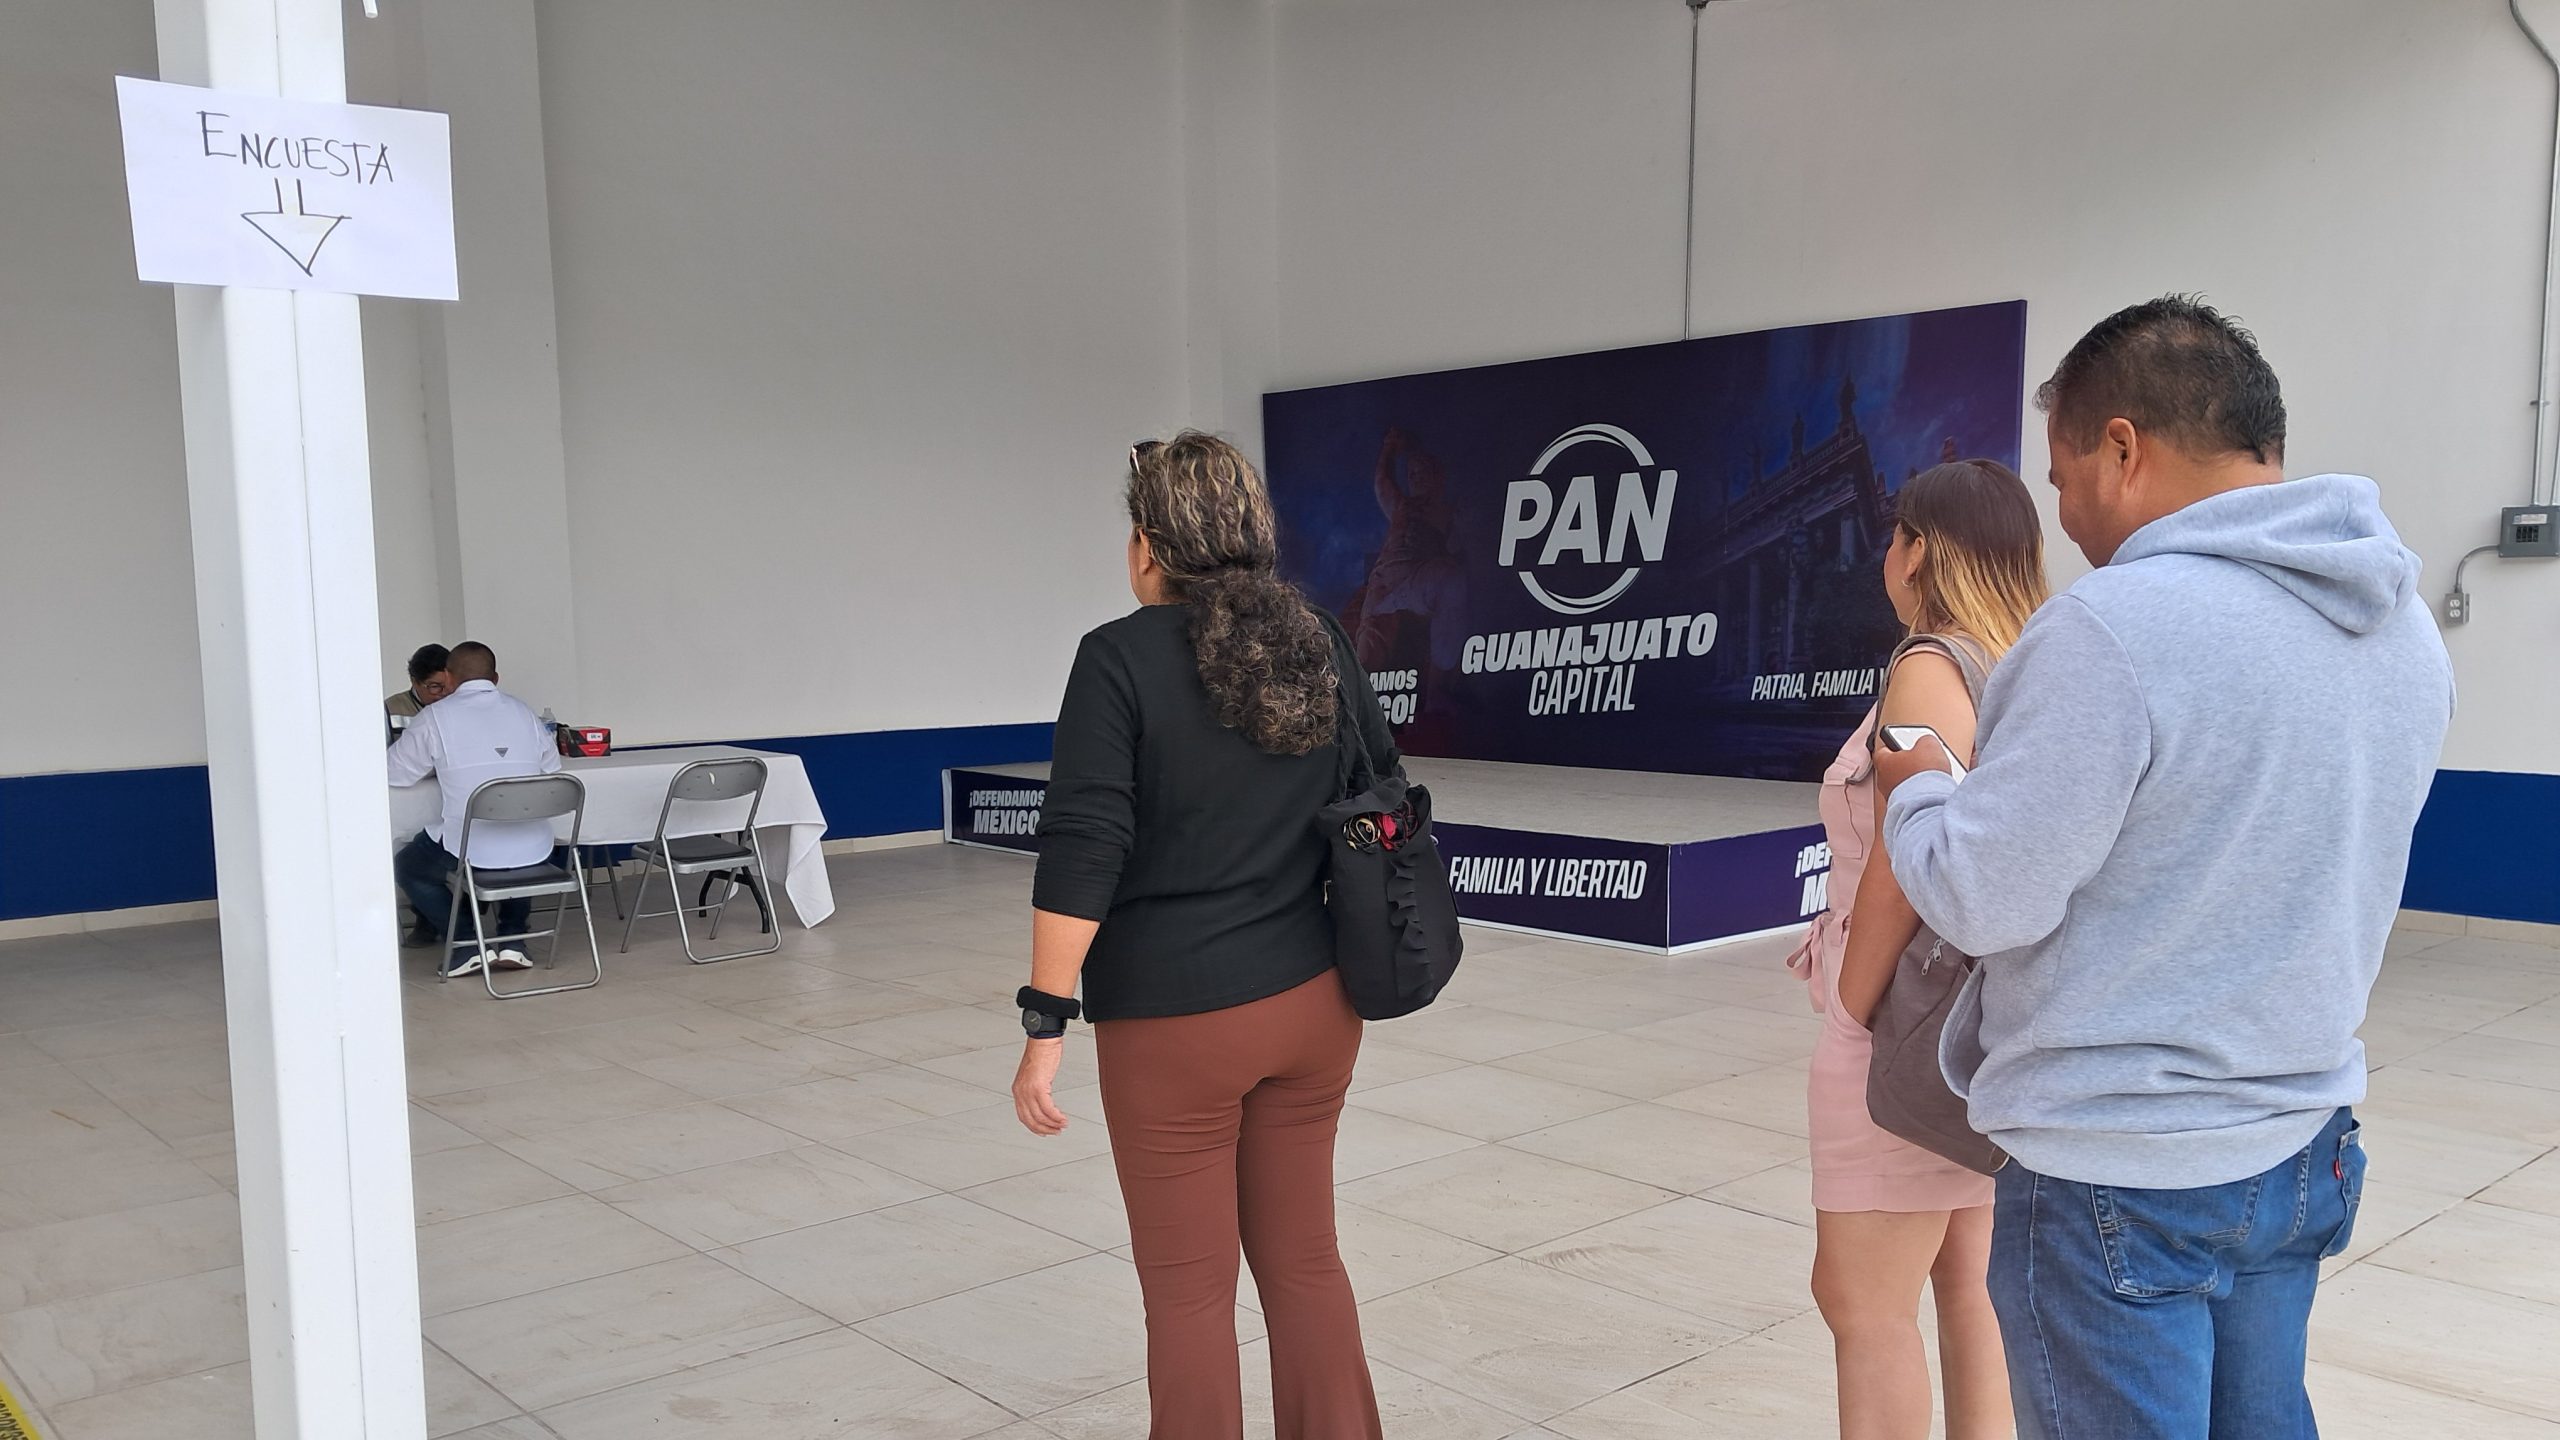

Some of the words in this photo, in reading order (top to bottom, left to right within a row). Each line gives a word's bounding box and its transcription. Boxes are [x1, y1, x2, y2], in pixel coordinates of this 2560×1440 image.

[196, 110, 394, 185] ENCUESTA
[1498, 469, 1678, 567] PAN
[1461, 612, 1718, 675] GUANAJUATO
[1528, 663, 1636, 716] CAPITAL
[1751, 672, 1807, 701] PATRIA,
[1811, 668, 1875, 698] FAMILIA
[969, 789, 1046, 808] ¡DEFENDAMOS
[1449, 856, 1525, 896] FAMILIA
[1529, 858, 1547, 896] Y
[1544, 858, 1648, 900] LIBERTAD
